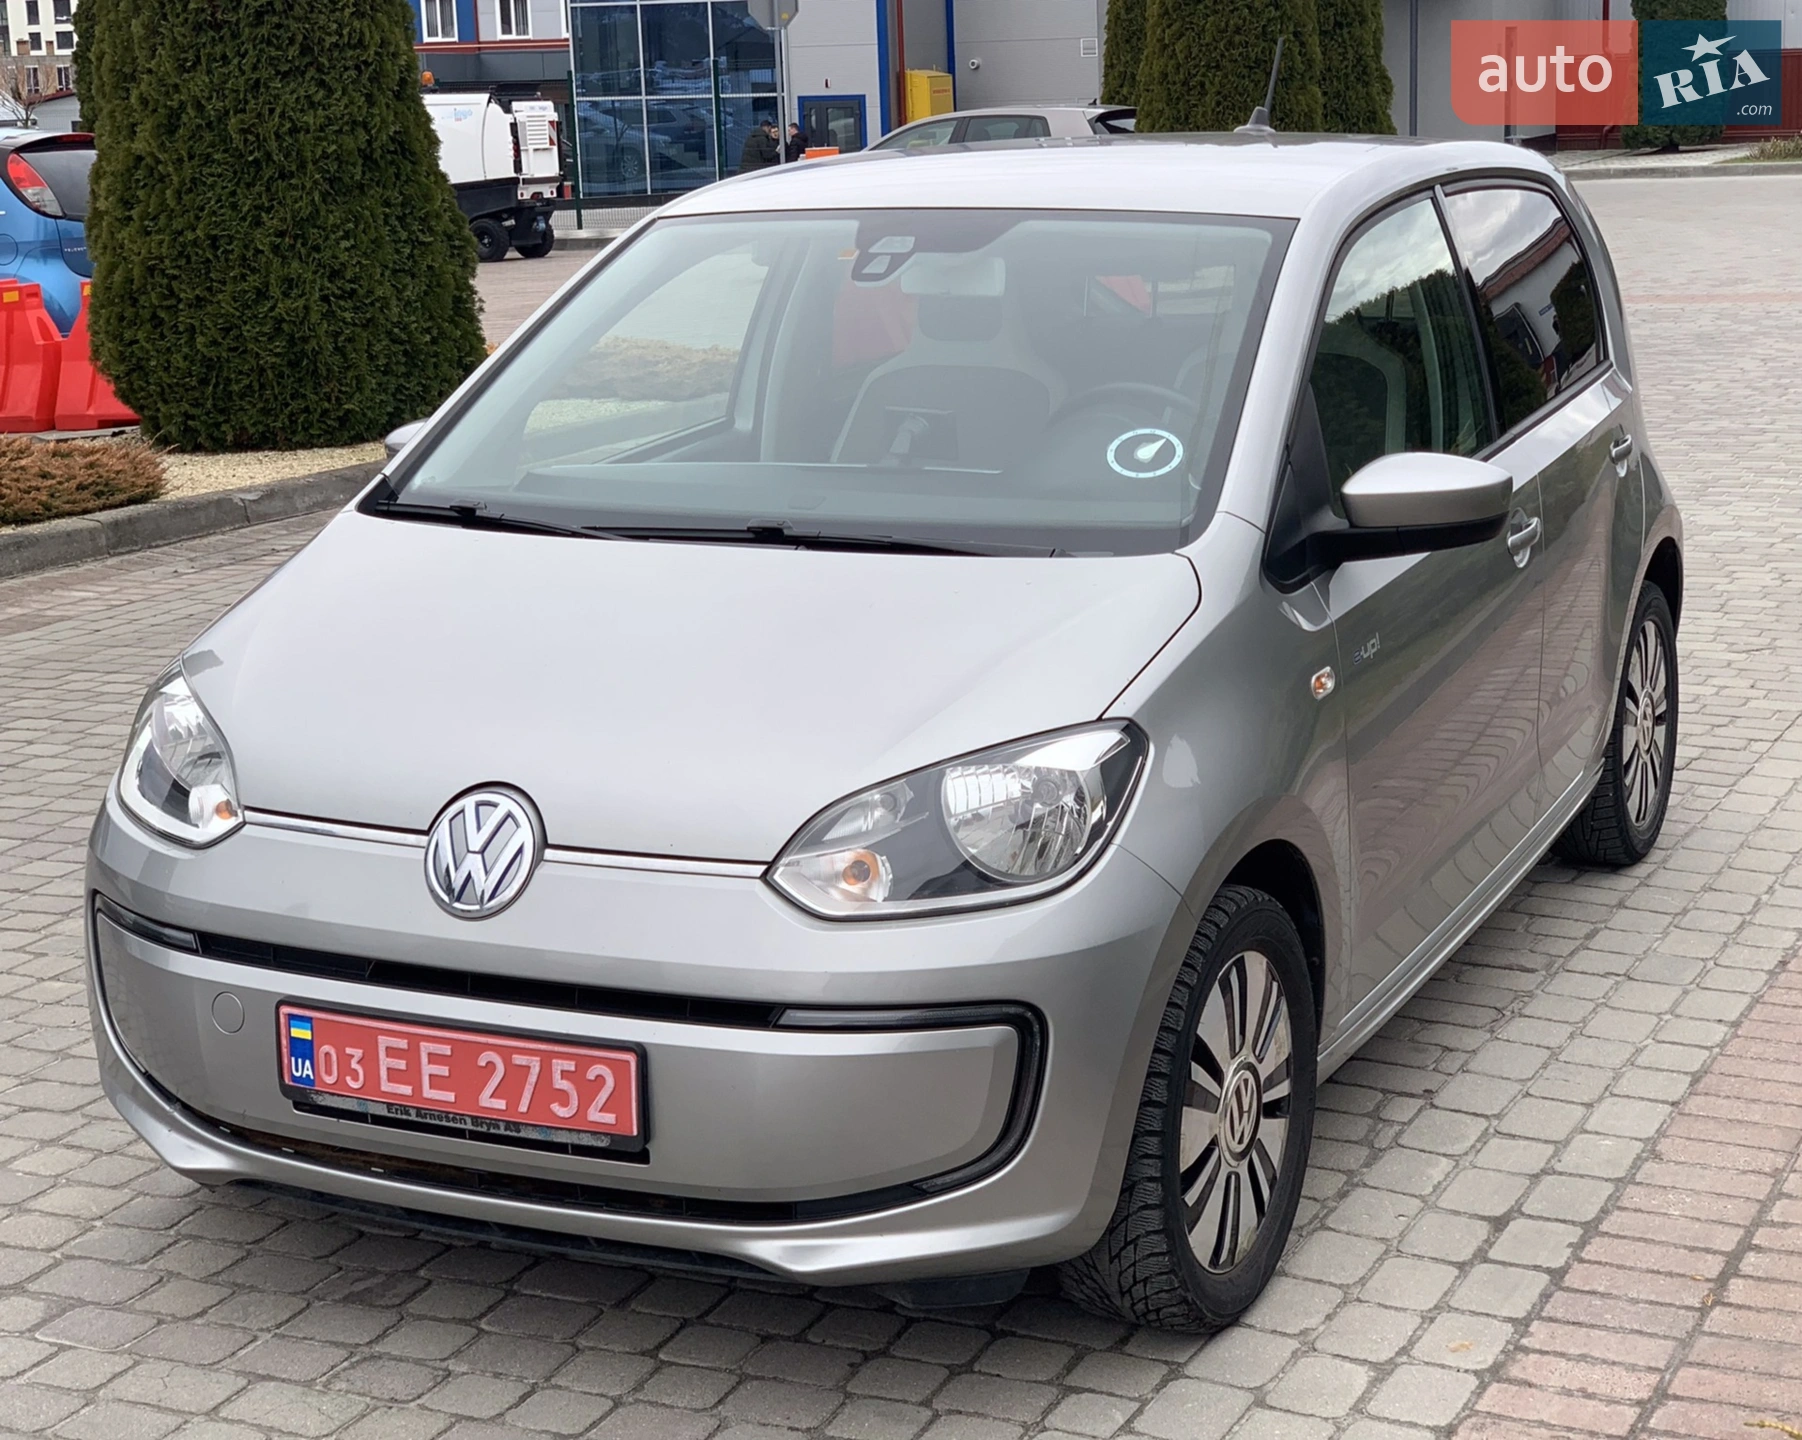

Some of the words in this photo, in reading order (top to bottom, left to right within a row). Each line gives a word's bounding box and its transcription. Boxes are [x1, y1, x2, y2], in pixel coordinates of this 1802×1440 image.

[291, 1056, 314, 1080] UA
[318, 1044, 364, 1089] 03
[377, 1035, 455, 1103] EE
[477, 1051, 617, 1125] 2752
[386, 1104, 412, 1117] Erik
[415, 1108, 467, 1126] Arnesen
